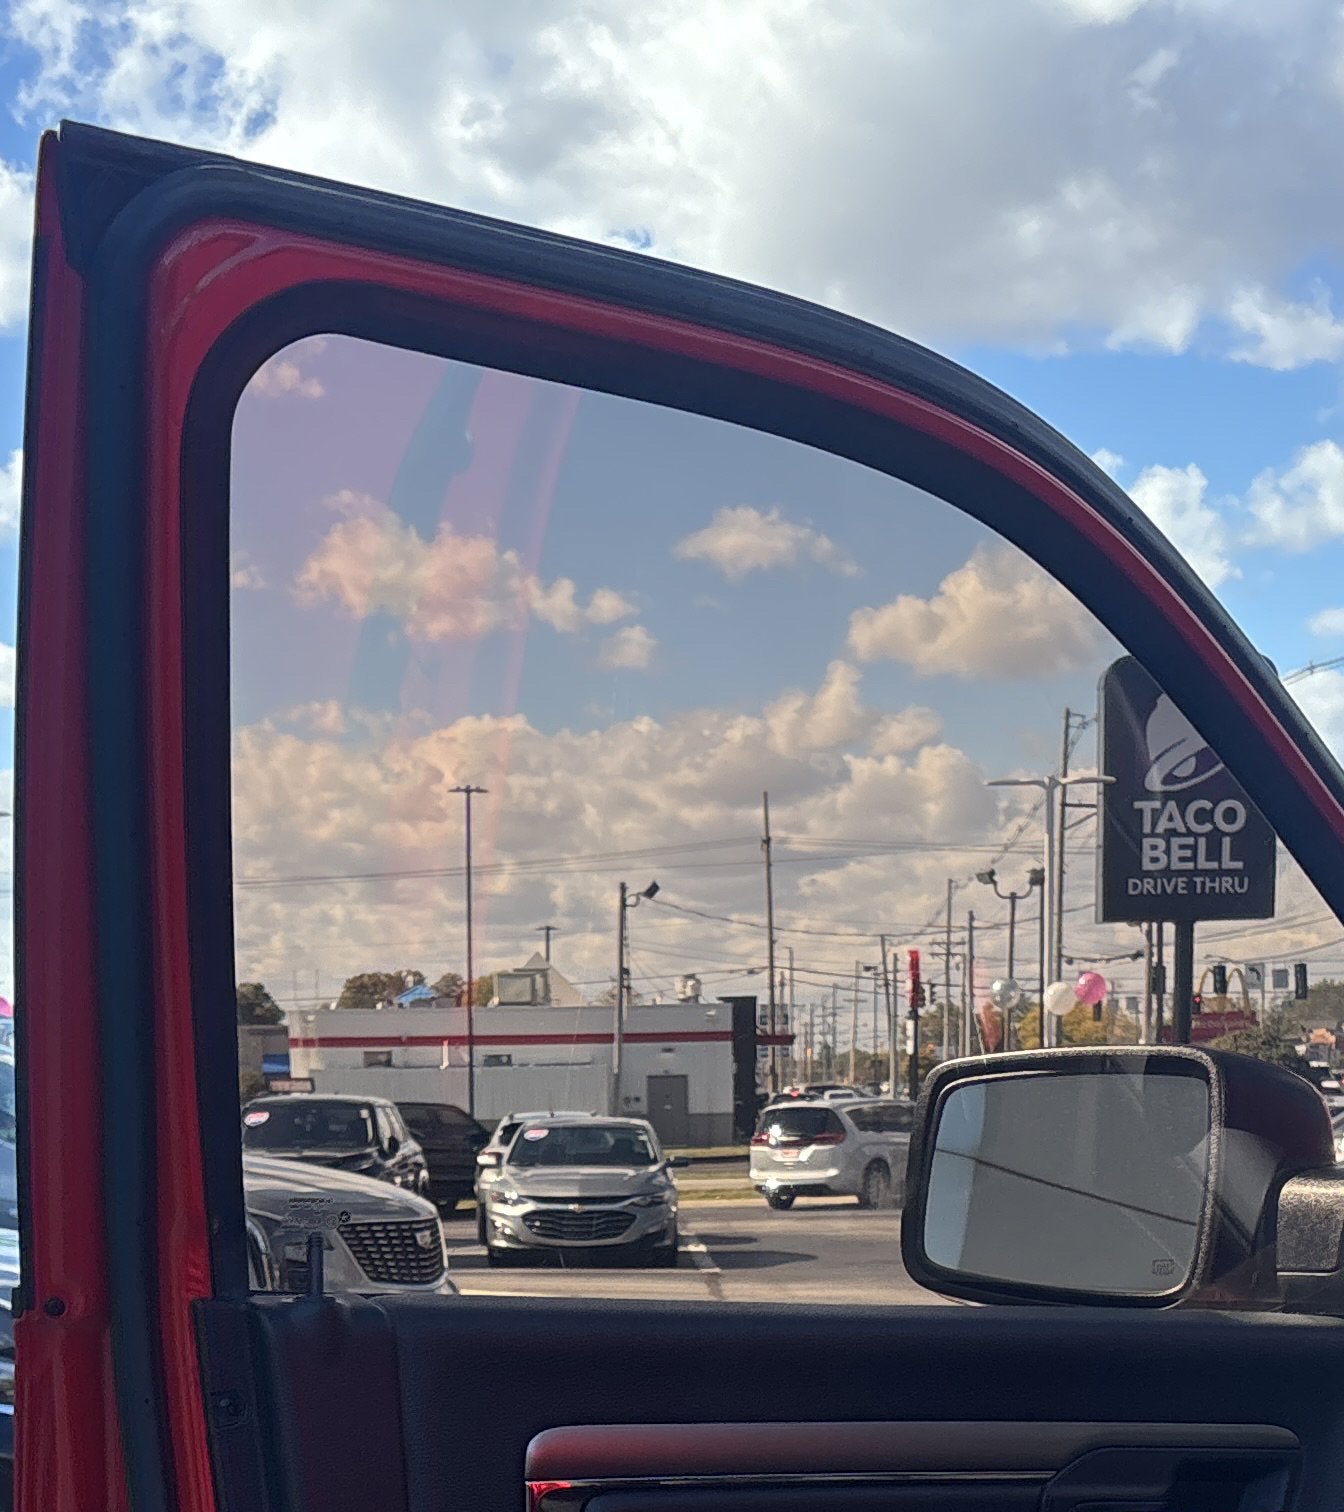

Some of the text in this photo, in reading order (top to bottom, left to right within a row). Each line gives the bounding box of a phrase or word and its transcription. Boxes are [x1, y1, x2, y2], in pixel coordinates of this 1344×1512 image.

[1133, 800, 1247, 834] TACO
[1142, 837, 1244, 871] BELL
[1128, 876, 1249, 895] DRIVE THRU
